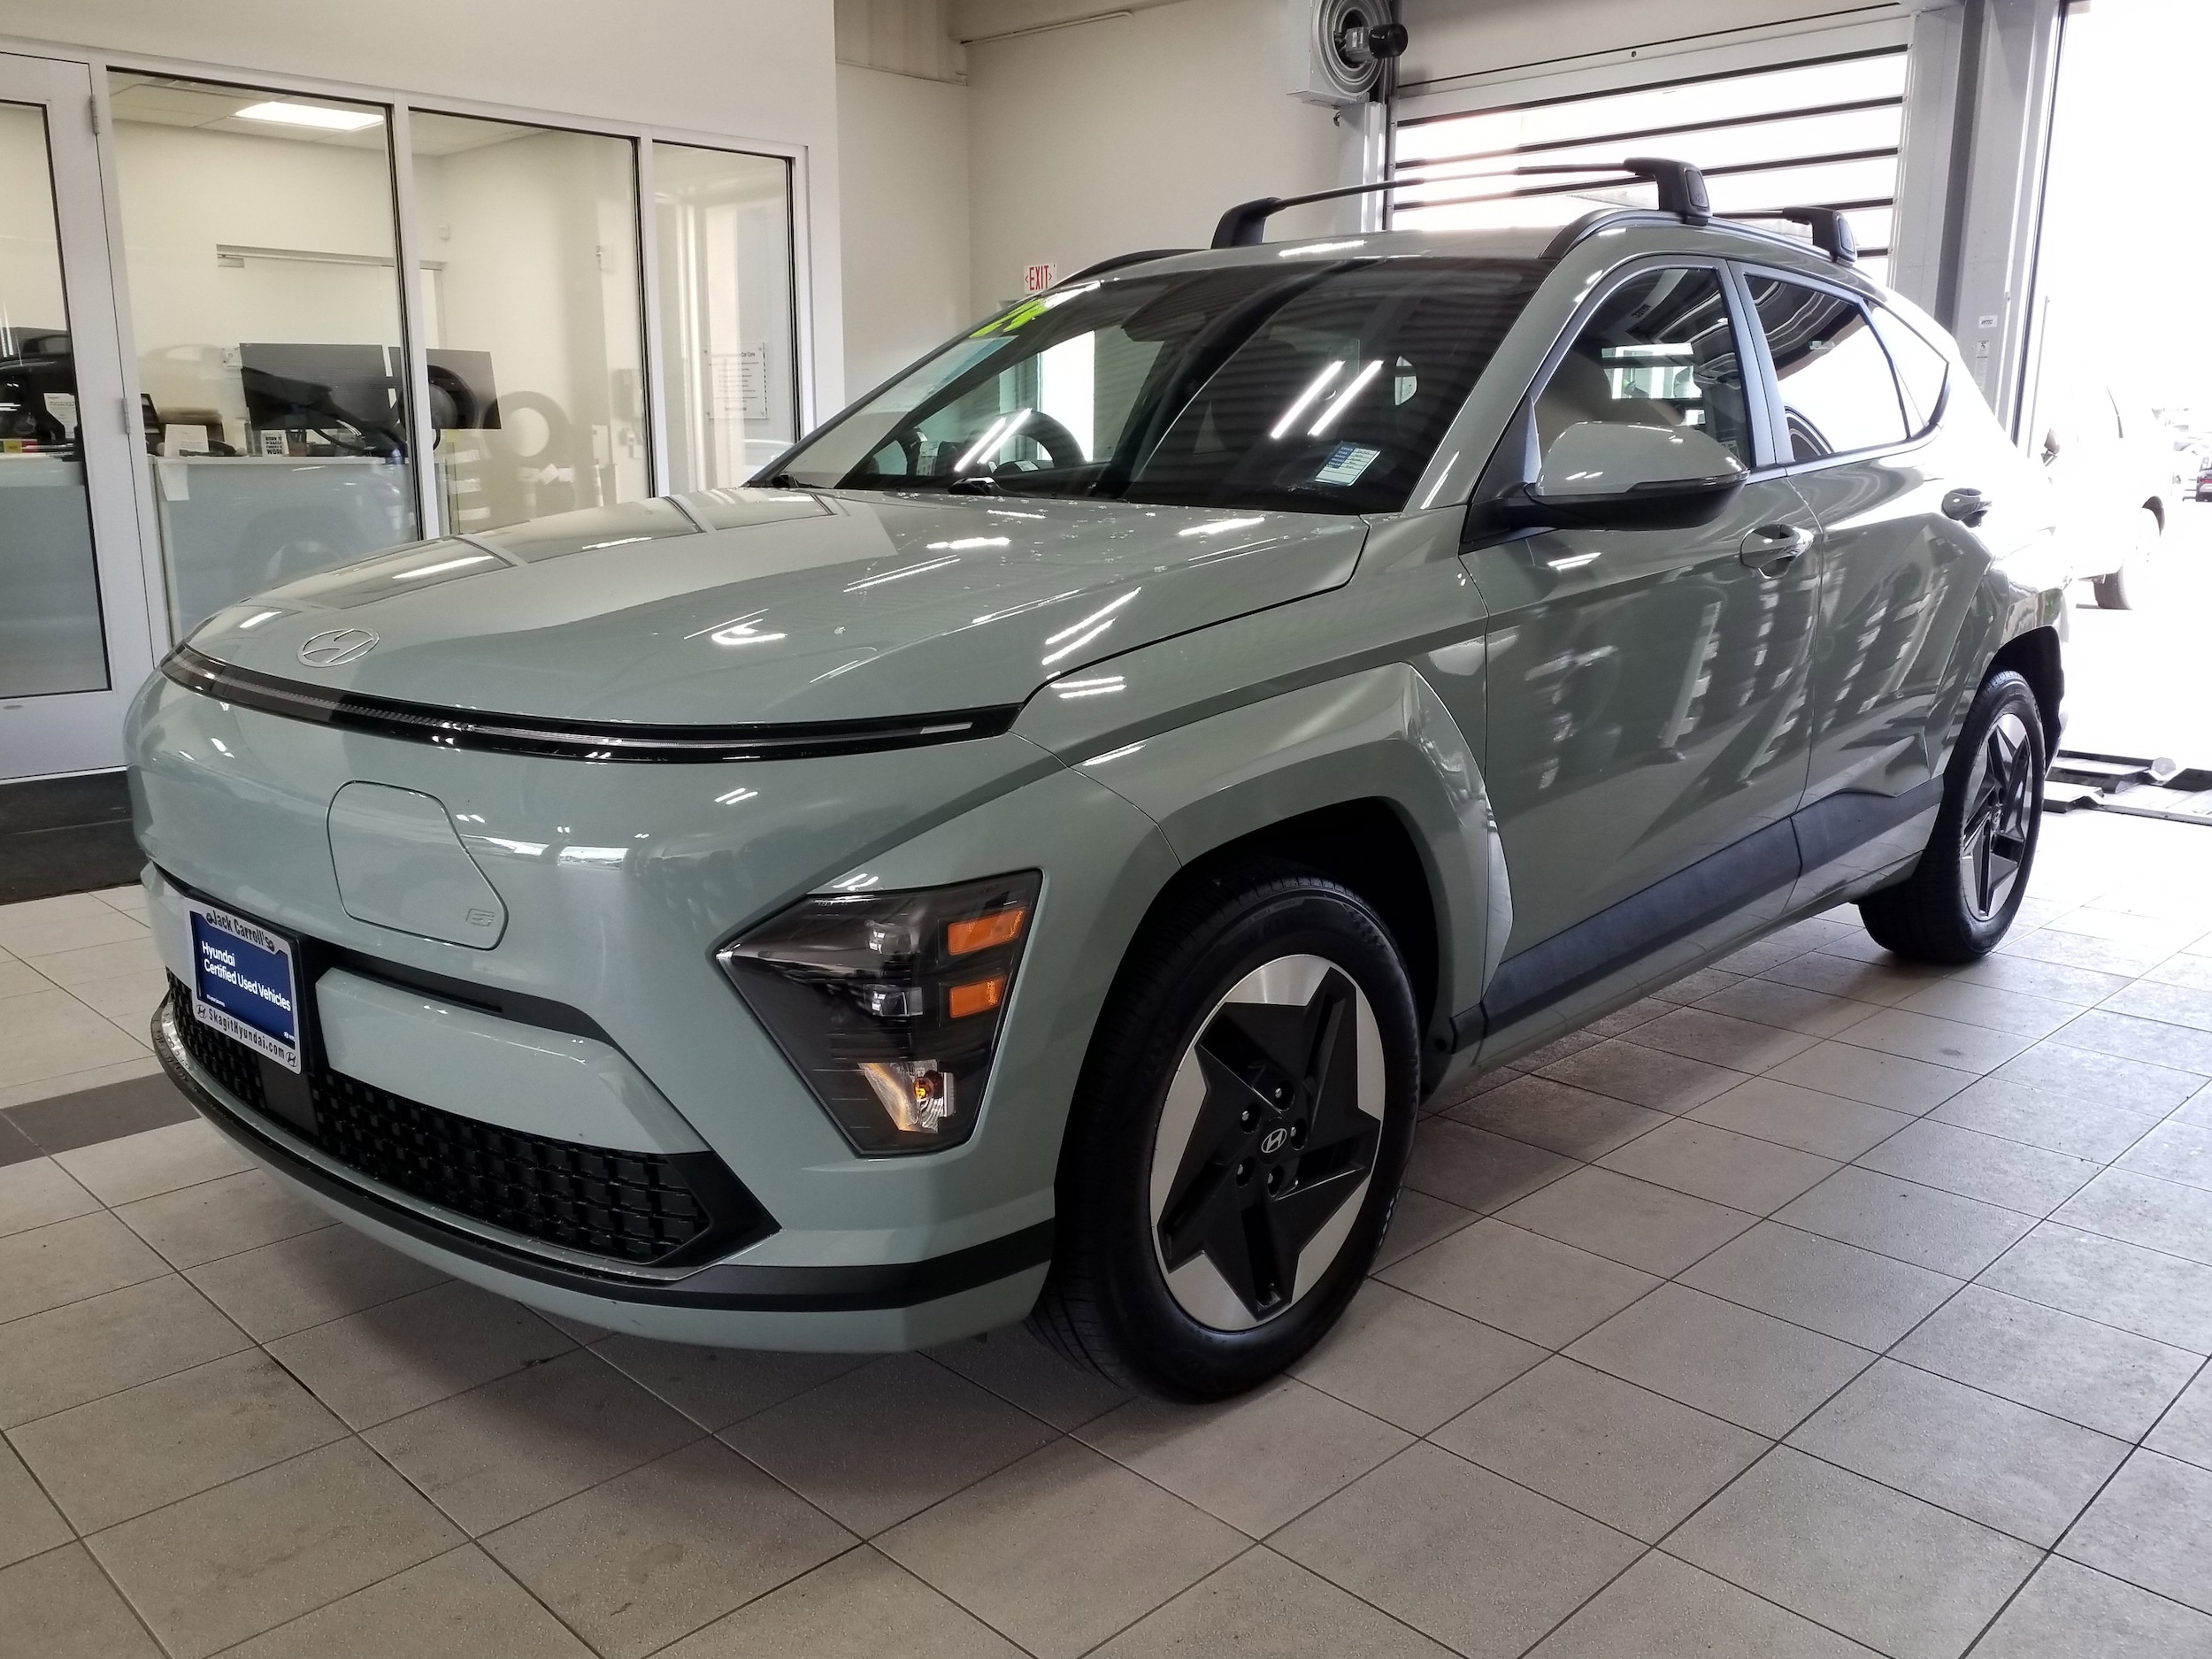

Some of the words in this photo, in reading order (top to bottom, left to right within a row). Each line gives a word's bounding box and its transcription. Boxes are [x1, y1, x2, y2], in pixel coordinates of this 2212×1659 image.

[1029, 265, 1049, 291] EXIT
[212, 910, 234, 933] Jack
[201, 940, 236, 968] Hyundai
[204, 958, 237, 986] Certified
[237, 972, 258, 995] Used
[257, 982, 291, 1012] Vehicles
[209, 1008, 285, 1059] SkagitHyundai.com
